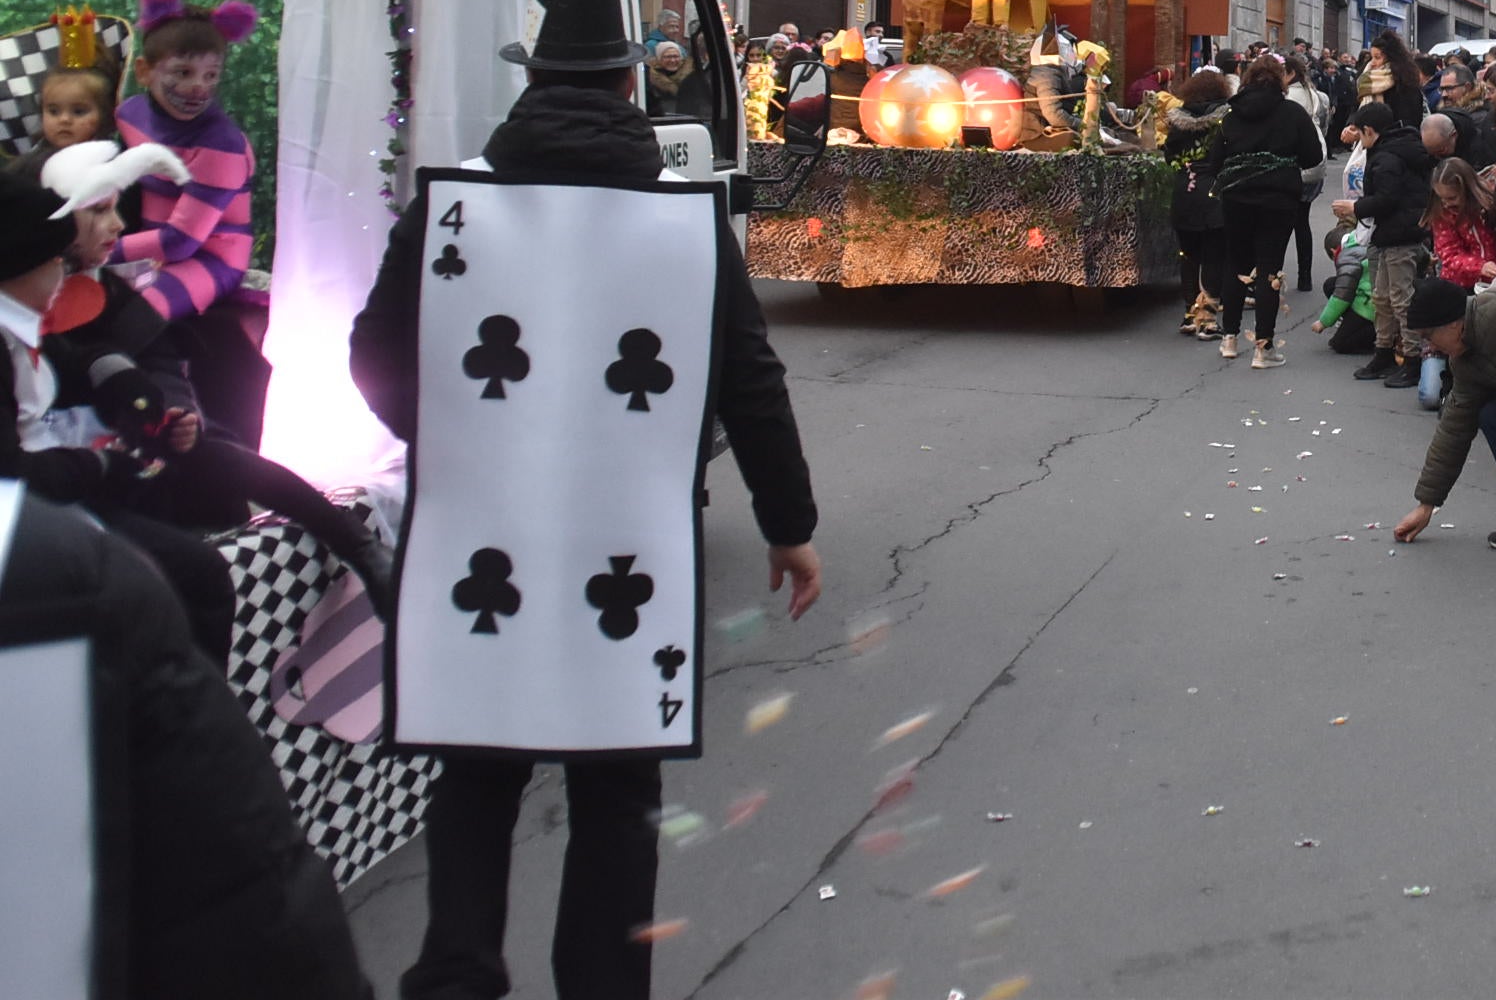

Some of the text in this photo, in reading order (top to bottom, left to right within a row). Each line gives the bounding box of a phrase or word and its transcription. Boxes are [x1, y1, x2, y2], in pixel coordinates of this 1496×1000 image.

[661, 142, 689, 168] ONES
[438, 200, 465, 235] 4
[658, 692, 683, 729] 4
